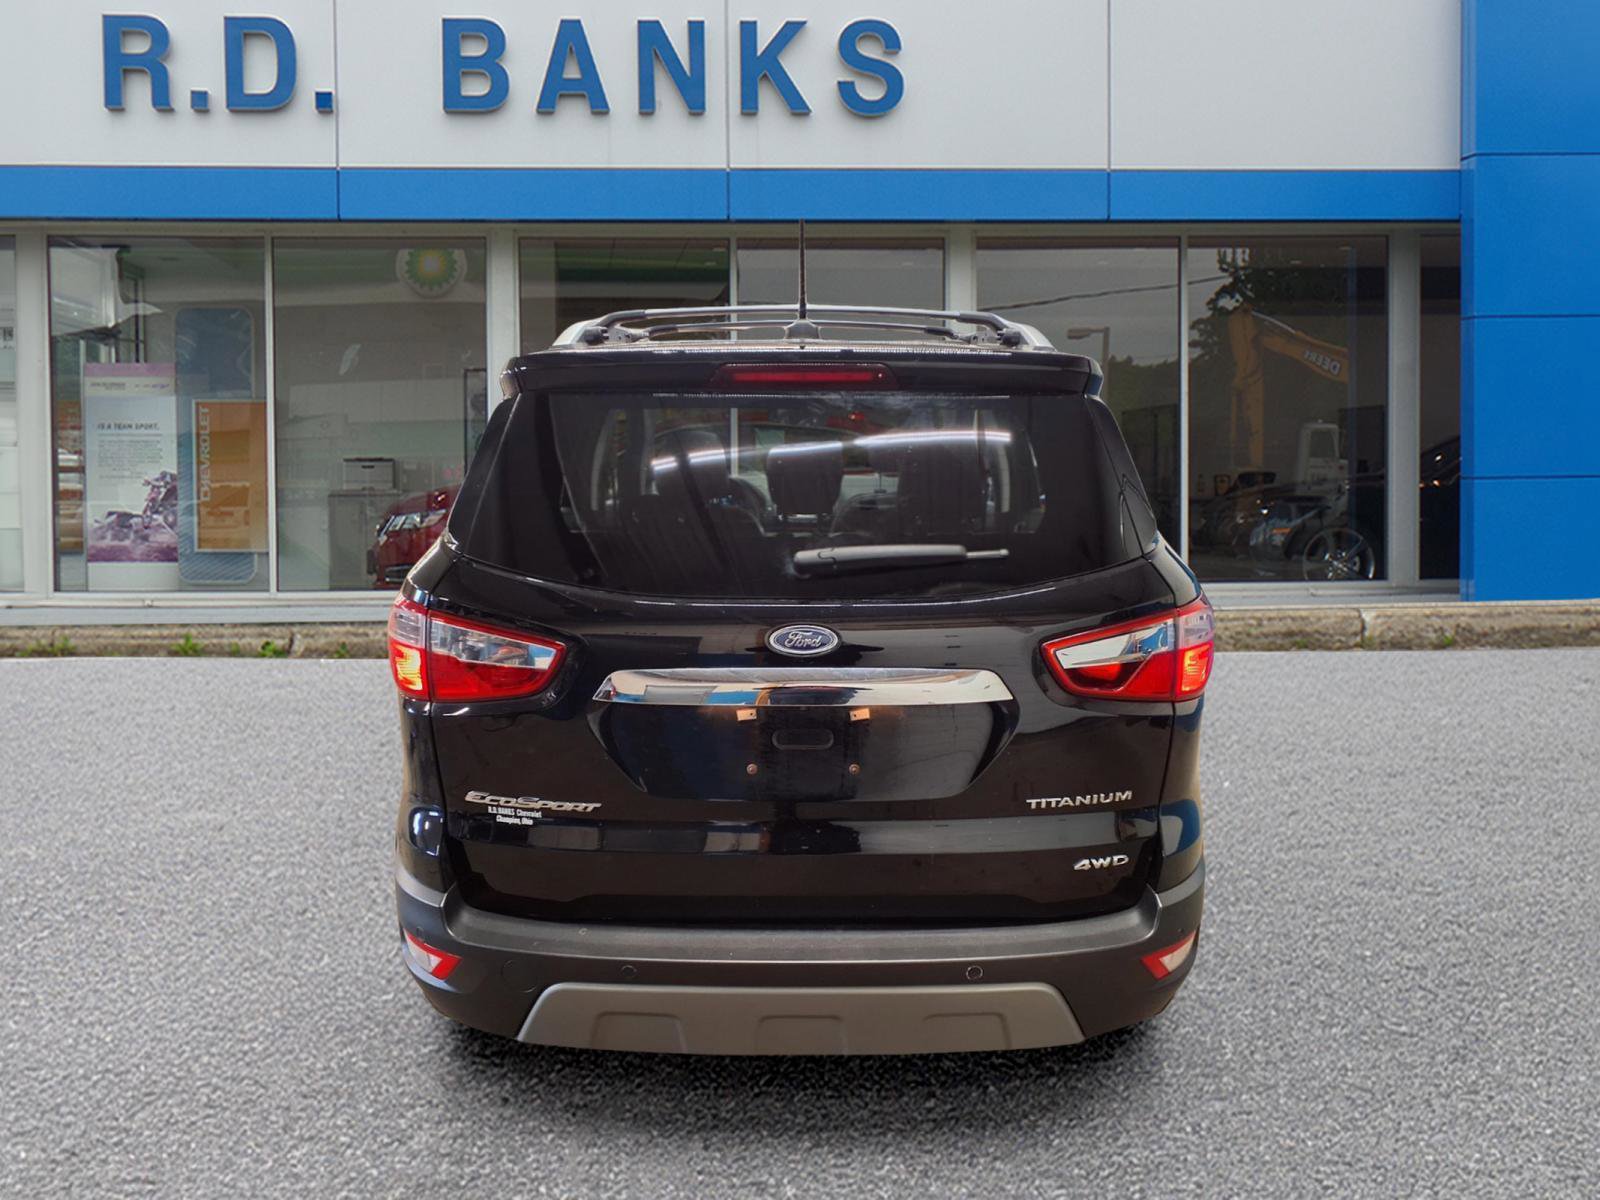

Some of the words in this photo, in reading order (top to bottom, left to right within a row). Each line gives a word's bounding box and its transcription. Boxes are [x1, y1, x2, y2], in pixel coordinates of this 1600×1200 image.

[102, 14, 335, 114] R.D.
[441, 17, 906, 117] BANKS
[113, 422, 133, 431] TEAM
[784, 630, 822, 648] Ford
[1025, 790, 1133, 809] TITANIUM
[516, 809, 542, 818] Chevrolet
[1073, 854, 1130, 871] 4WD
